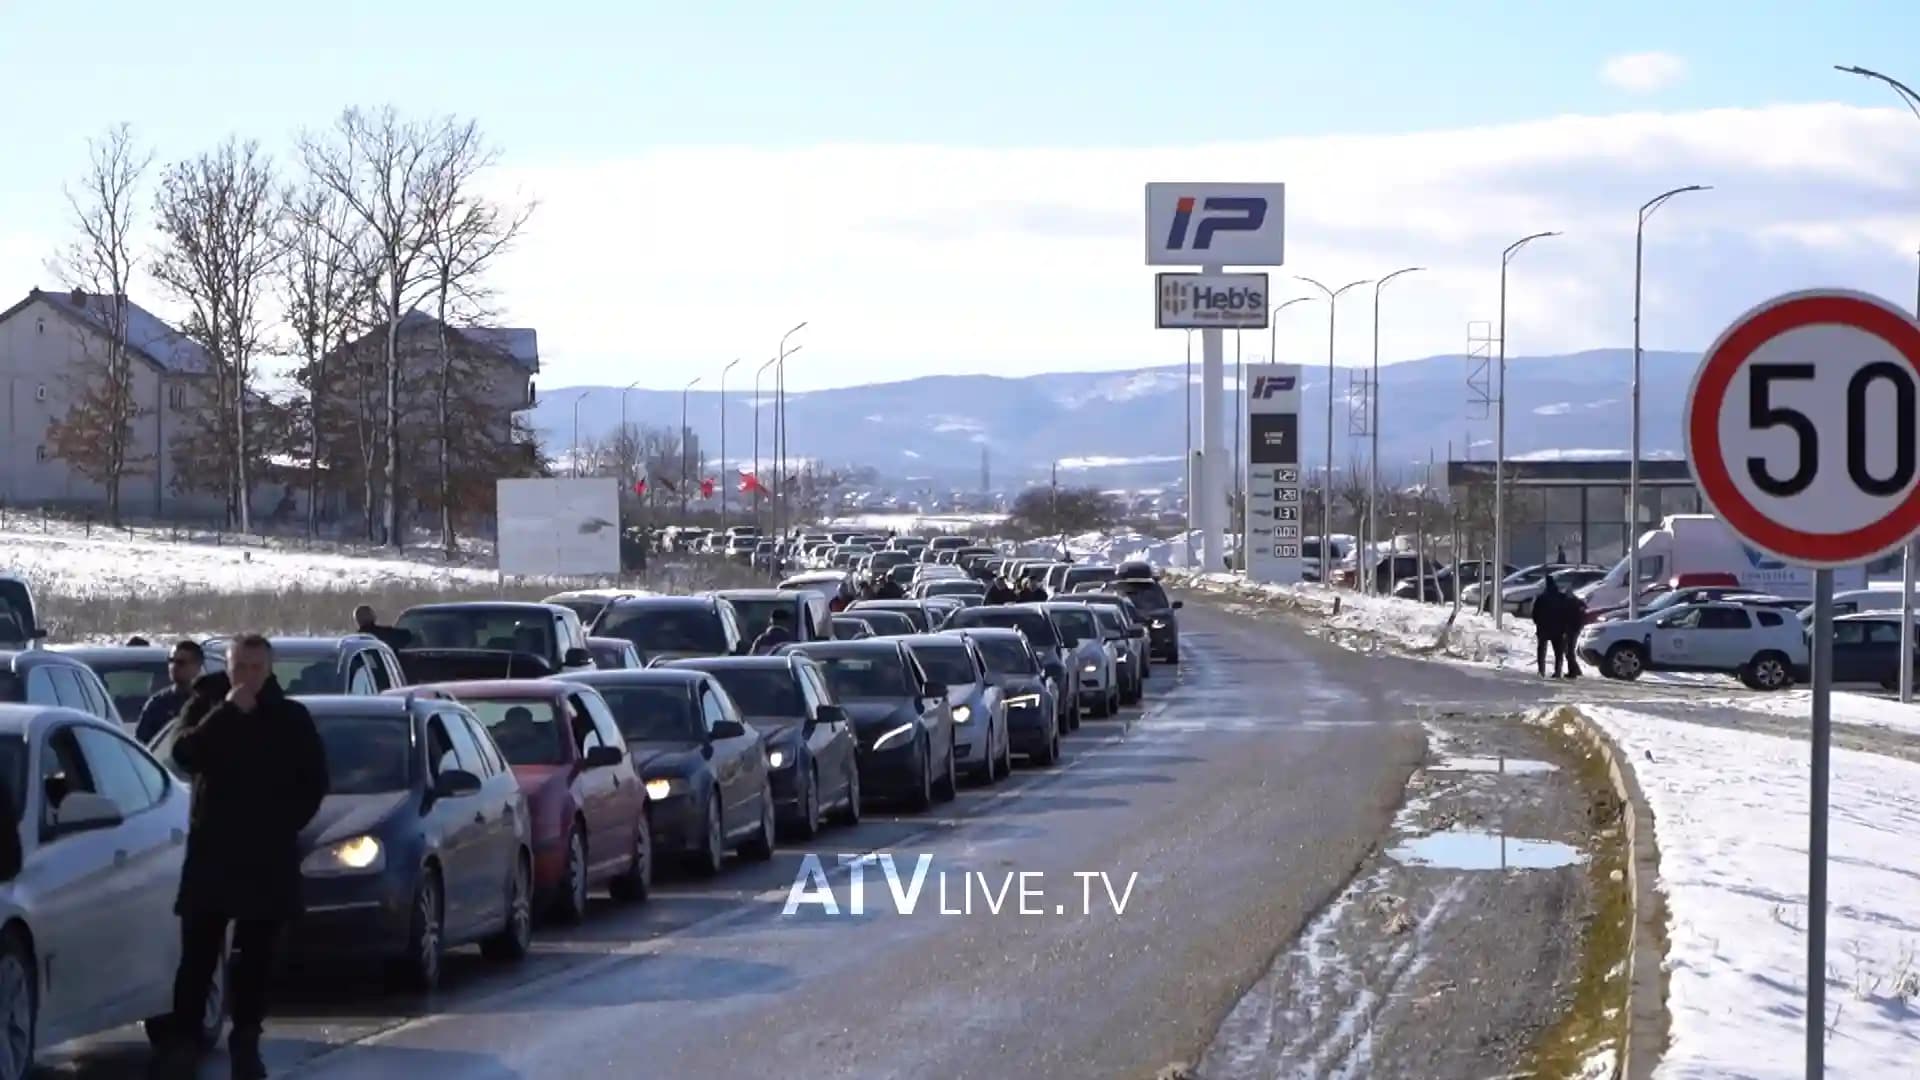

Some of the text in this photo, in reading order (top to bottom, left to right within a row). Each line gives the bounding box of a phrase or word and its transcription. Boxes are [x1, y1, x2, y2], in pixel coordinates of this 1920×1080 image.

[1166, 196, 1267, 249] IP
[1193, 286, 1262, 310] Heb's
[1252, 376, 1296, 400] IP
[1746, 361, 1916, 498] 50
